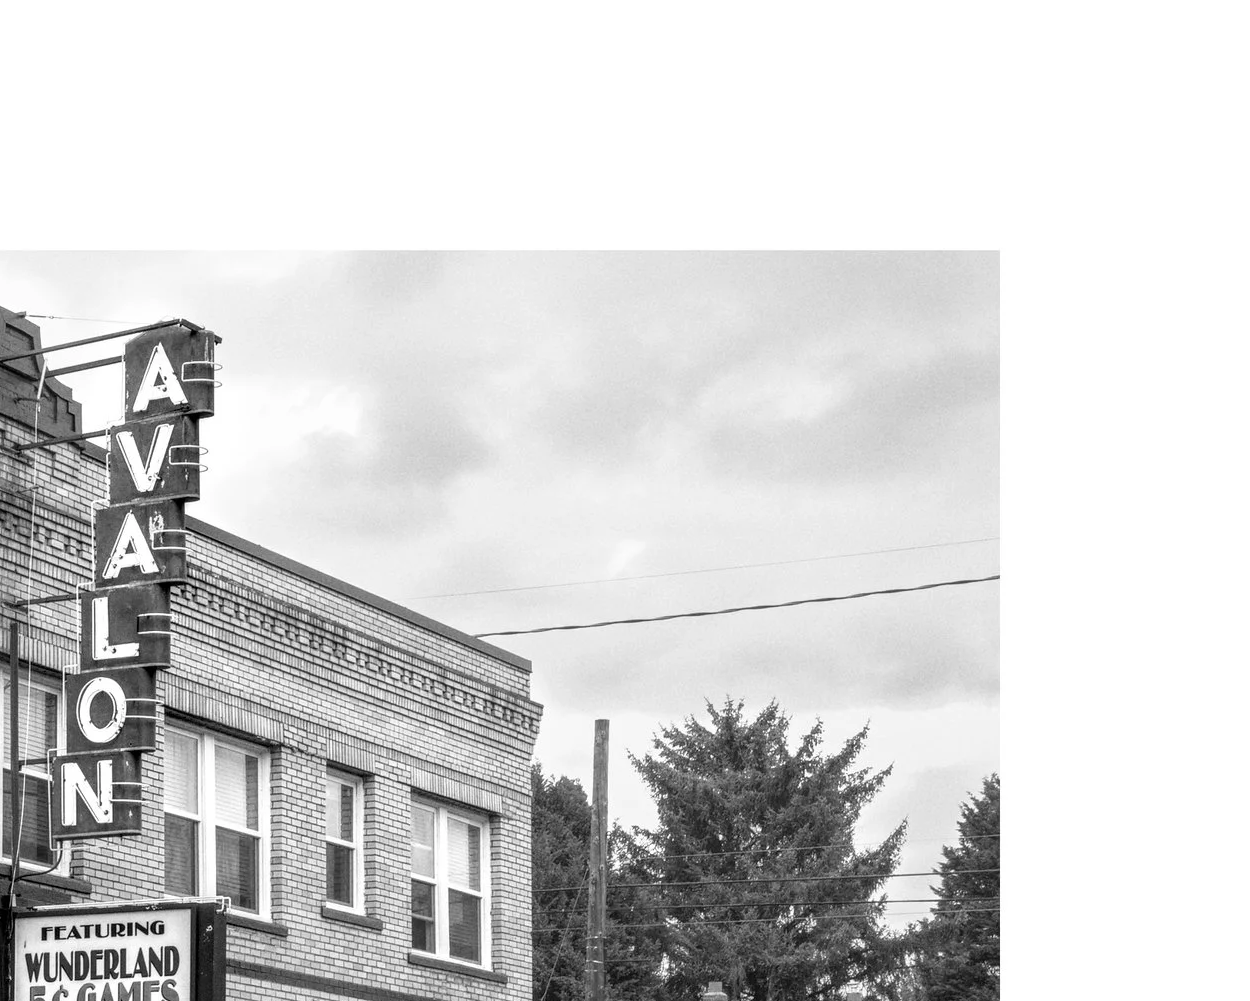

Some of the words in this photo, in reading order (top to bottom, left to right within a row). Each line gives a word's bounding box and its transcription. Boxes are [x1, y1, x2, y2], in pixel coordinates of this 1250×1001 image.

[61, 342, 188, 827] AVALON
[41, 920, 165, 941] FEATURING
[25, 945, 180, 983] WUNDERLAND
